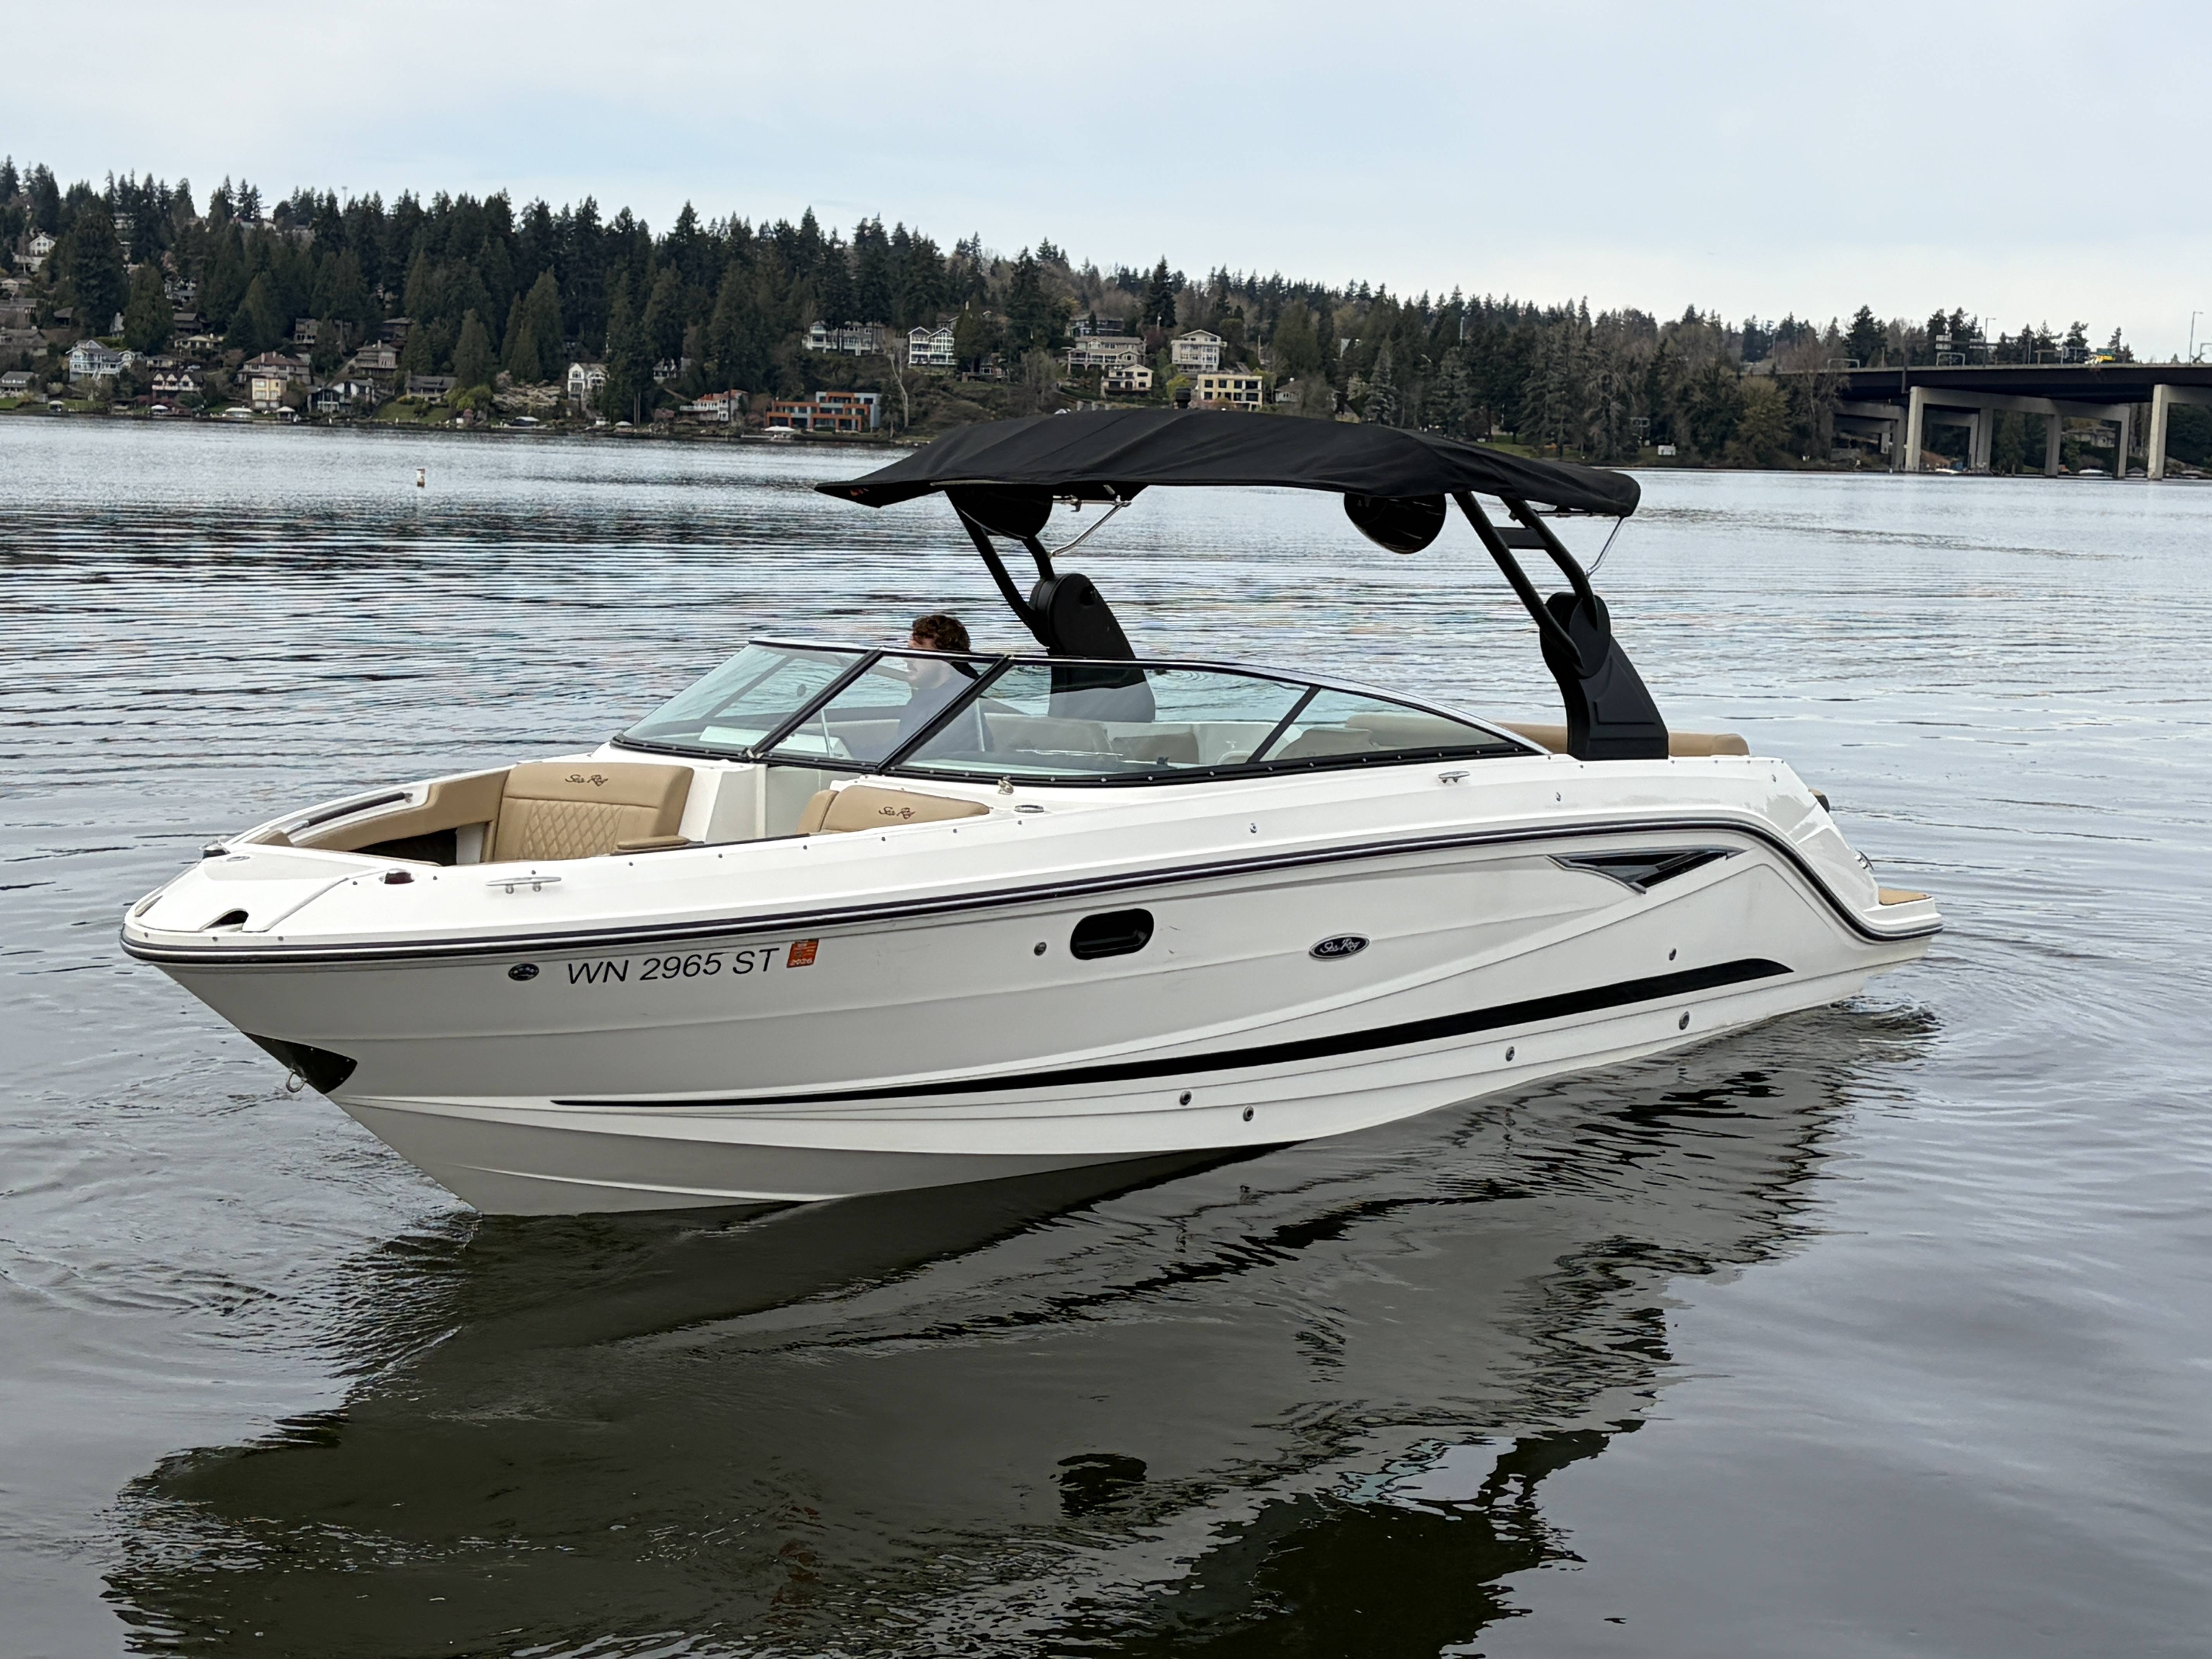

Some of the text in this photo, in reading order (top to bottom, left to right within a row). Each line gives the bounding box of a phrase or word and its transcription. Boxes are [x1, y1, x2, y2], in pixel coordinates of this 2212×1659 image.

[1320, 941, 1339, 953] Sea
[568, 948, 780, 984] WN 2965 ST
